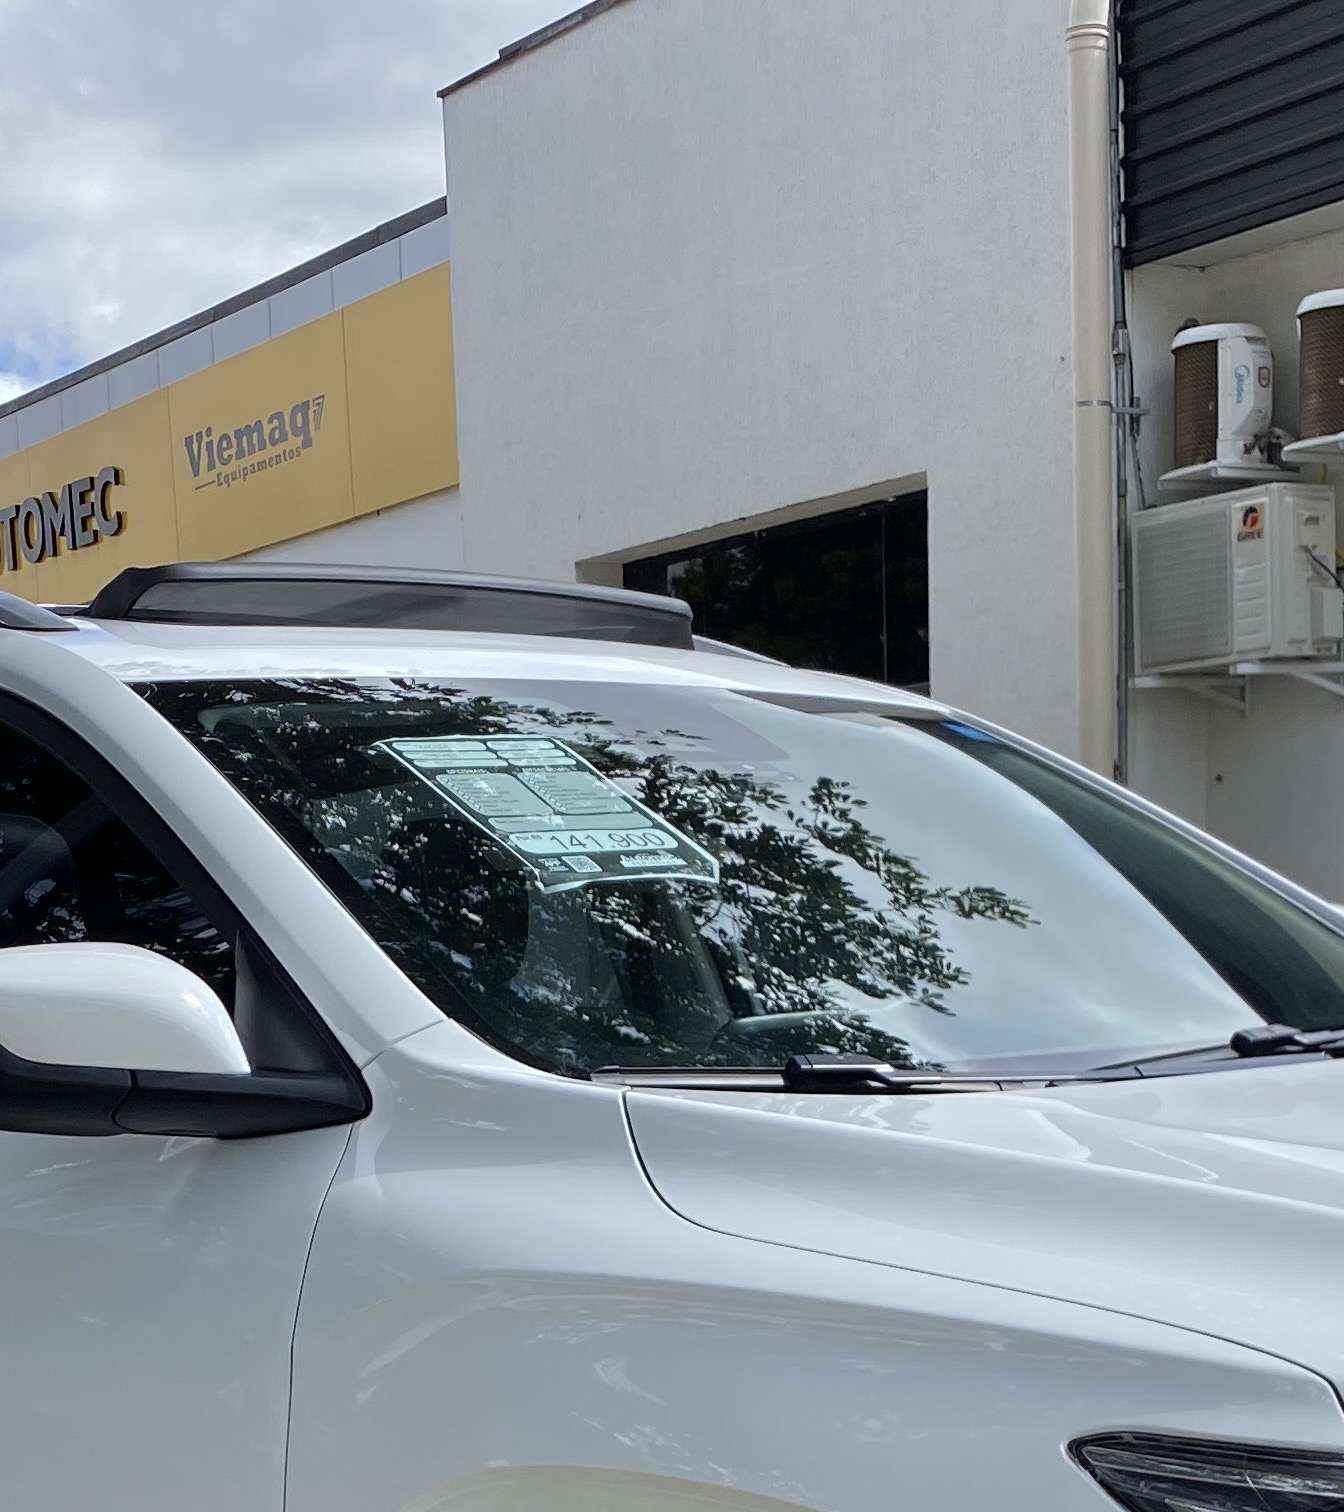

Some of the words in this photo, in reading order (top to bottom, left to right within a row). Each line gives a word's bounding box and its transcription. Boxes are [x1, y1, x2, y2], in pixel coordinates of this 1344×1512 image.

[184, 397, 314, 478] Viemaq
[216, 445, 302, 488] Equipamentos
[549, 831, 666, 851] 141.900
